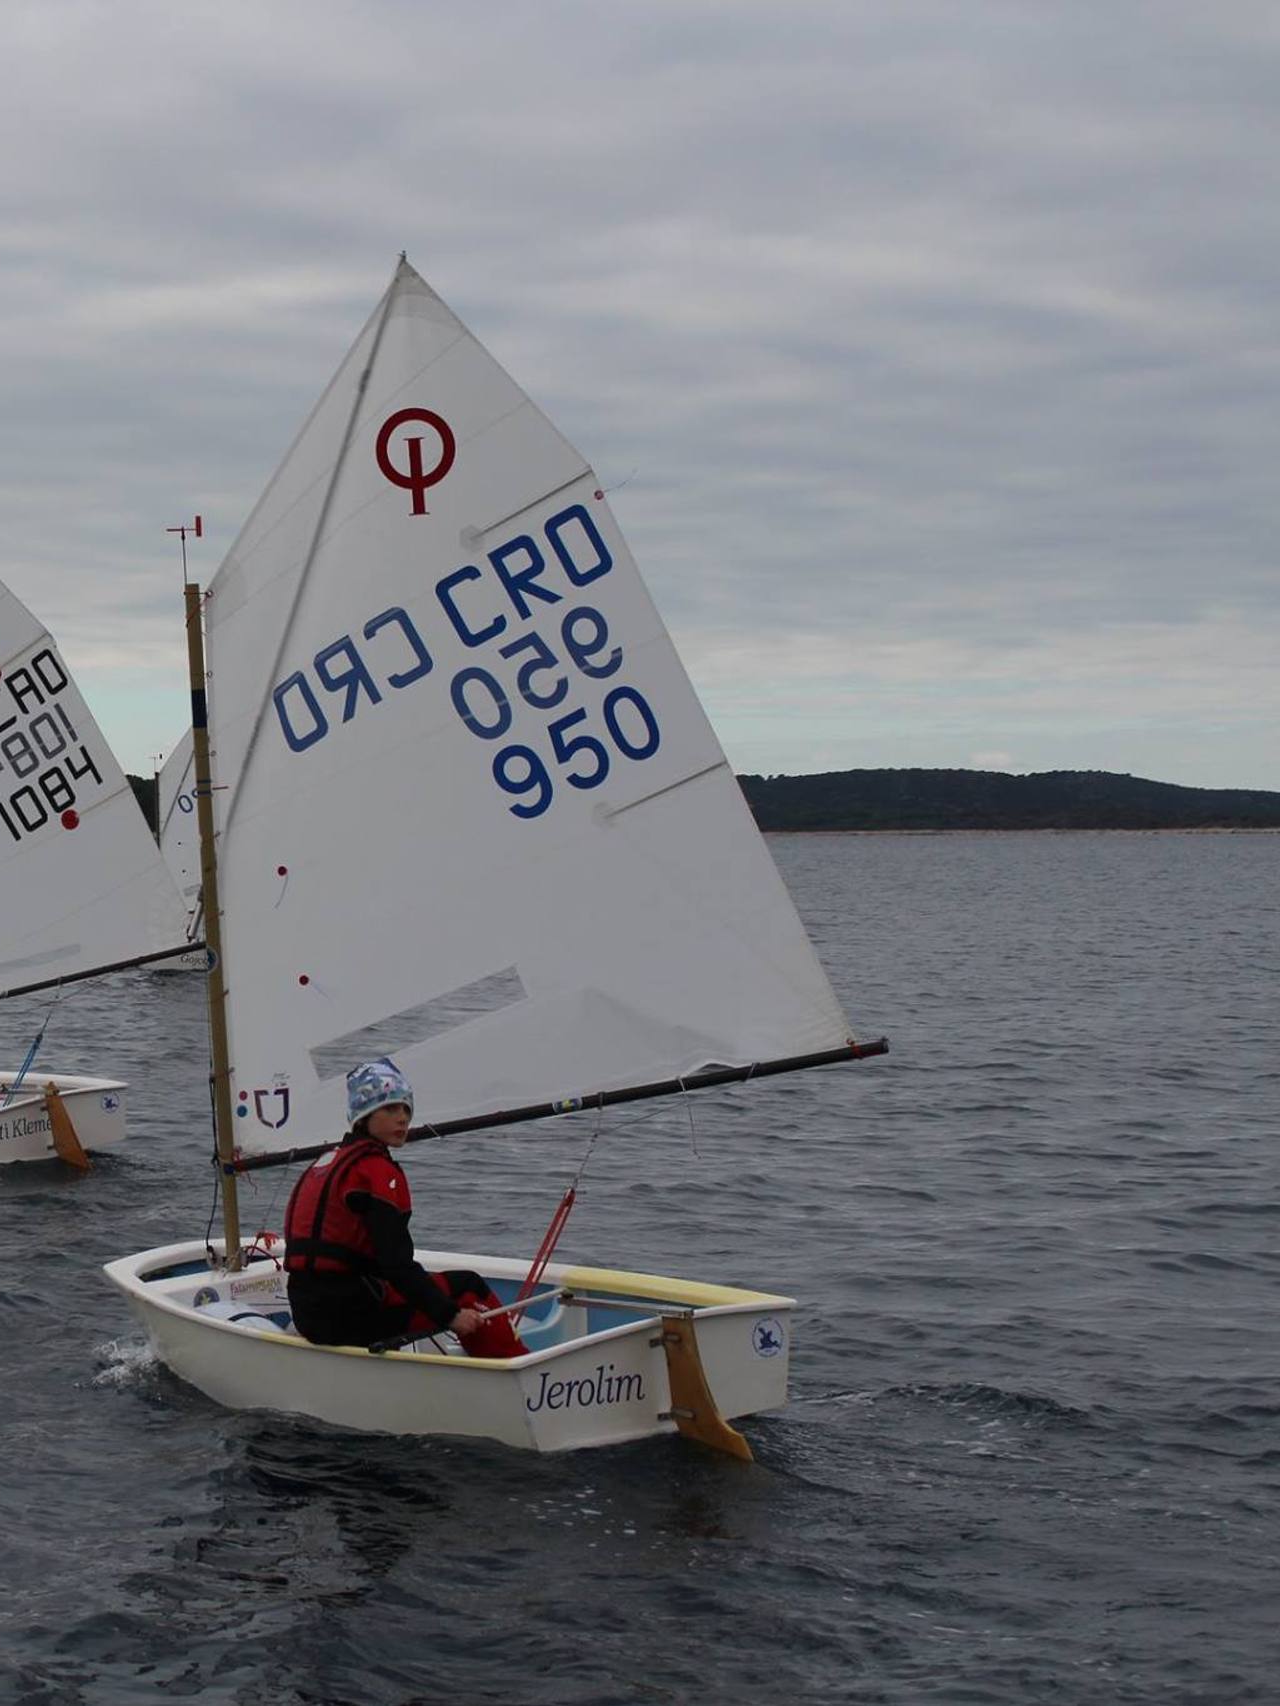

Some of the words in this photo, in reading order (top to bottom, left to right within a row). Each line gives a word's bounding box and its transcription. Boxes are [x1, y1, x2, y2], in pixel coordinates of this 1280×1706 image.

[434, 503, 613, 649] CRO
[491, 685, 661, 820] 950
[526, 1363, 646, 1413] Jerolim
